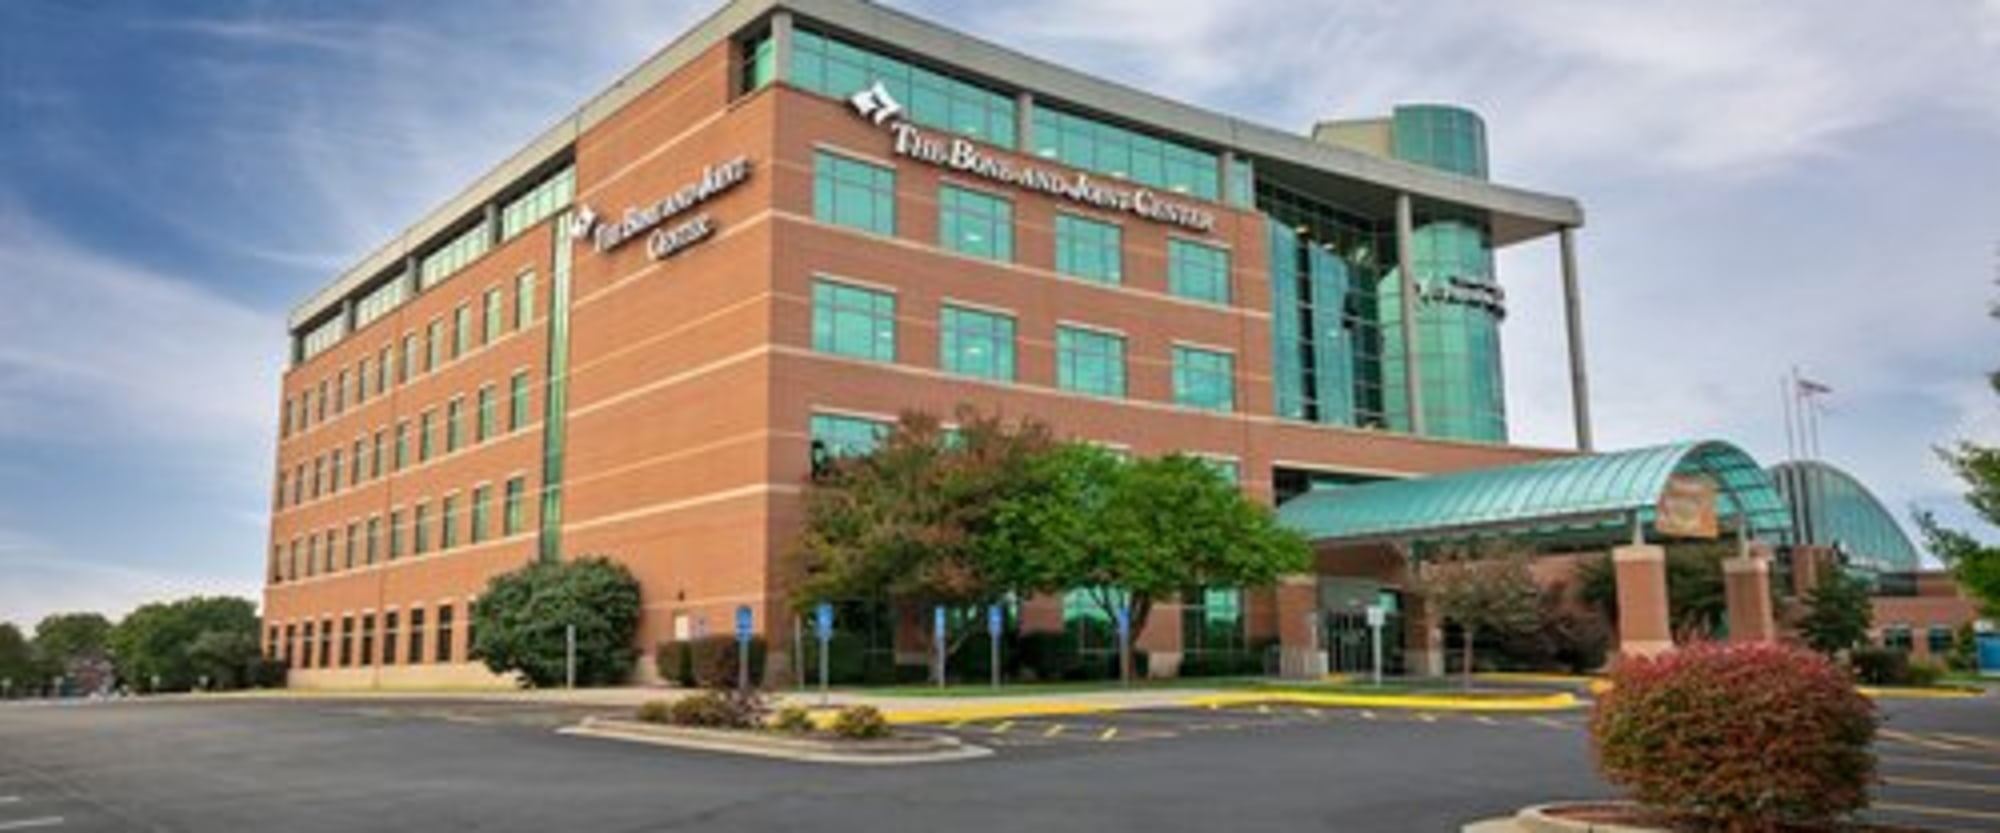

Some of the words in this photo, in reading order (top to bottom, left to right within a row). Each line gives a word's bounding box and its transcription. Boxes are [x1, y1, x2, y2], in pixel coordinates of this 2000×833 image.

[951, 138, 1014, 182] BONE
[1018, 166, 1065, 194] AND
[1134, 188, 1215, 231] CENTER
